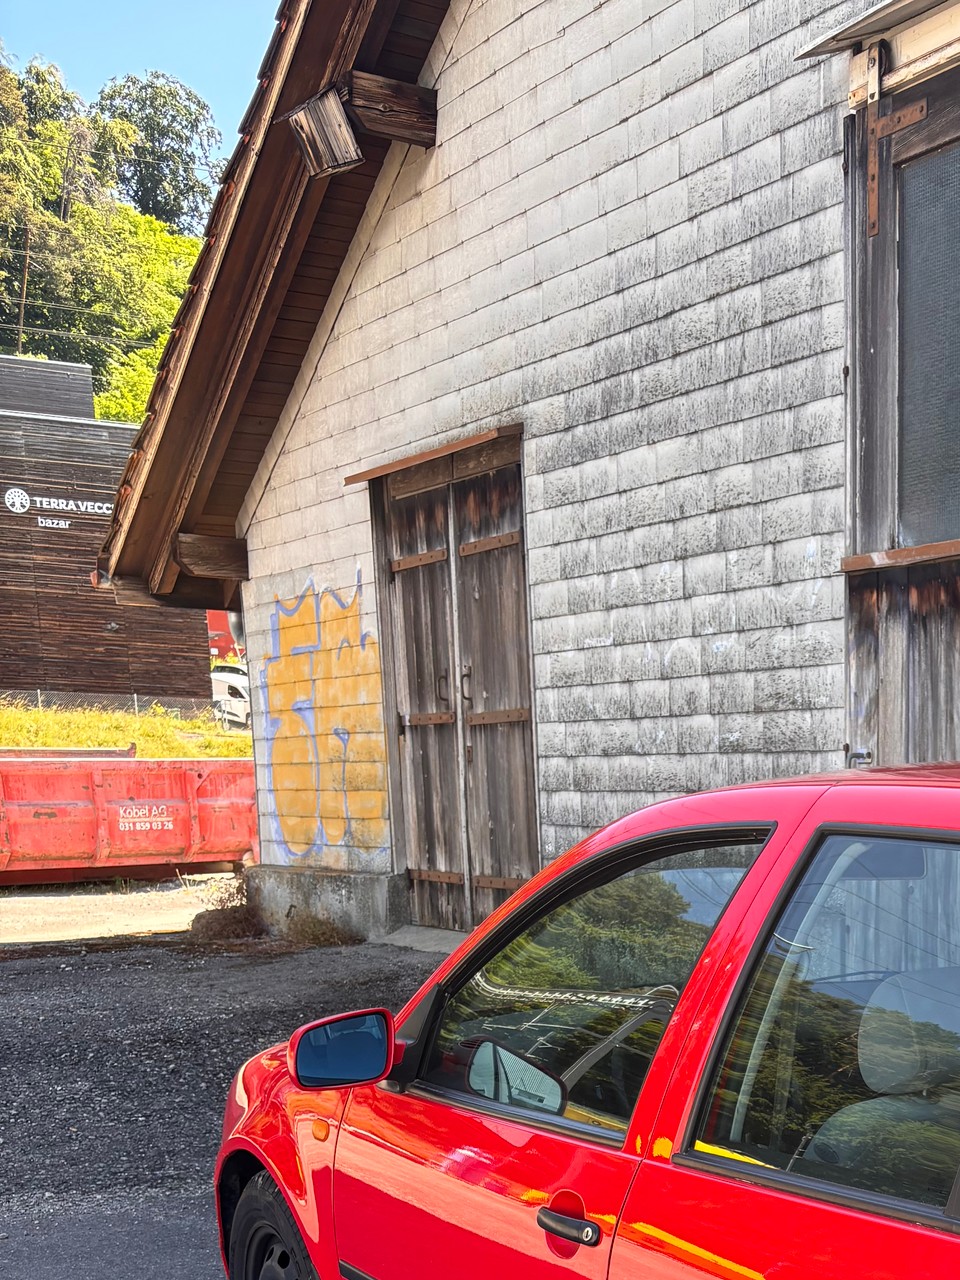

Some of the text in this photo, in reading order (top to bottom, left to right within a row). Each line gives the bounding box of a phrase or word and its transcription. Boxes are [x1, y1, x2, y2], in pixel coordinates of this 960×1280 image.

[33, 497, 115, 514] TERRA VECC
[37, 516, 71, 529] bazar
[119, 805, 149, 818] Kobel
[119, 821, 174, 831] 031 859 03 26
